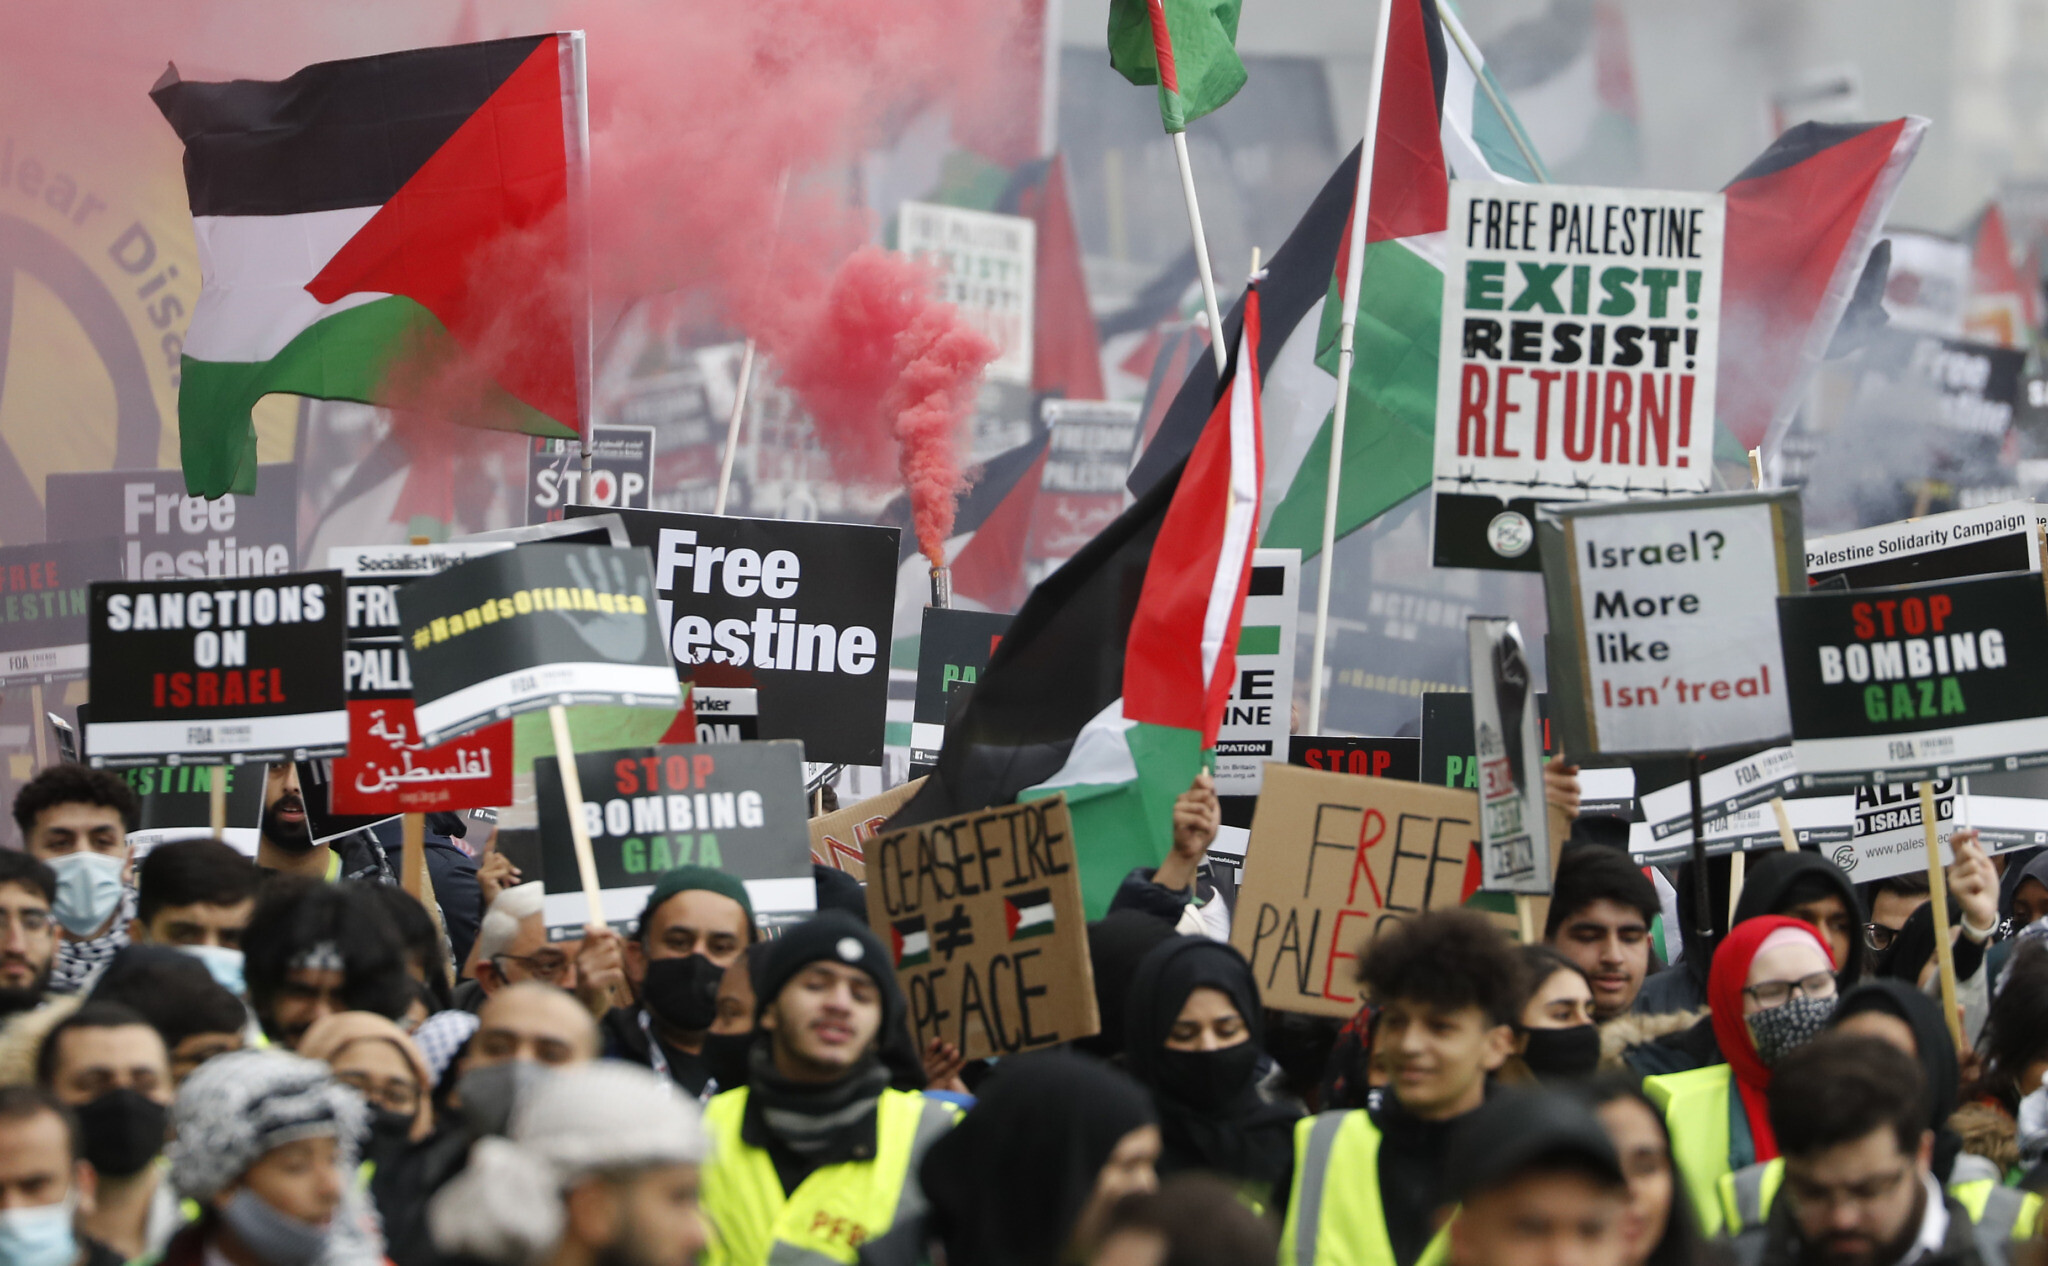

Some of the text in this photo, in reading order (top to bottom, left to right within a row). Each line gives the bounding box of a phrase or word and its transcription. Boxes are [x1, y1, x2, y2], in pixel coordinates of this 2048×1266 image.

[1, 138, 107, 226] lear
[1468, 198, 1703, 258] FREE PALESTINE
[1464, 261, 1702, 320] EXIST!
[1463, 318, 1699, 369] RESIST!
[1456, 363, 1695, 468] RETURN!
[124, 483, 236, 534] Free
[535, 469, 644, 508] STOP
[1587, 530, 1725, 569] Israel?
[1806, 513, 2025, 567] Palestine Solidarity Campaign
[656, 528, 799, 599] Free
[4, 588, 87, 623] ESTIN
[107, 583, 326, 631] SANCTIONS
[1594, 591, 1699, 619] More
[1852, 594, 1953, 640] STOP
[194, 630, 246, 668] ON
[1597, 632, 1670, 663] like
[1818, 628, 2007, 685] BOMBING
[153, 668, 286, 708] ISRAEL
[1864, 676, 1967, 723] GAZA
[1222, 706, 1271, 726] INE
[126, 765, 235, 795] ESTINE
[355, 747, 492, 793] لفلسطين
[614, 754, 715, 794] STOP
[1304, 749, 1391, 777] STOP
[583, 790, 764, 838] BOMBING
[1870, 806, 1921, 832] ISRAE
[622, 833, 723, 874] GAZA
[880, 800, 1070, 916] CEASEFIRE
[1304, 803, 1471, 916] FREE
[910, 949, 1058, 1057] PEACE
